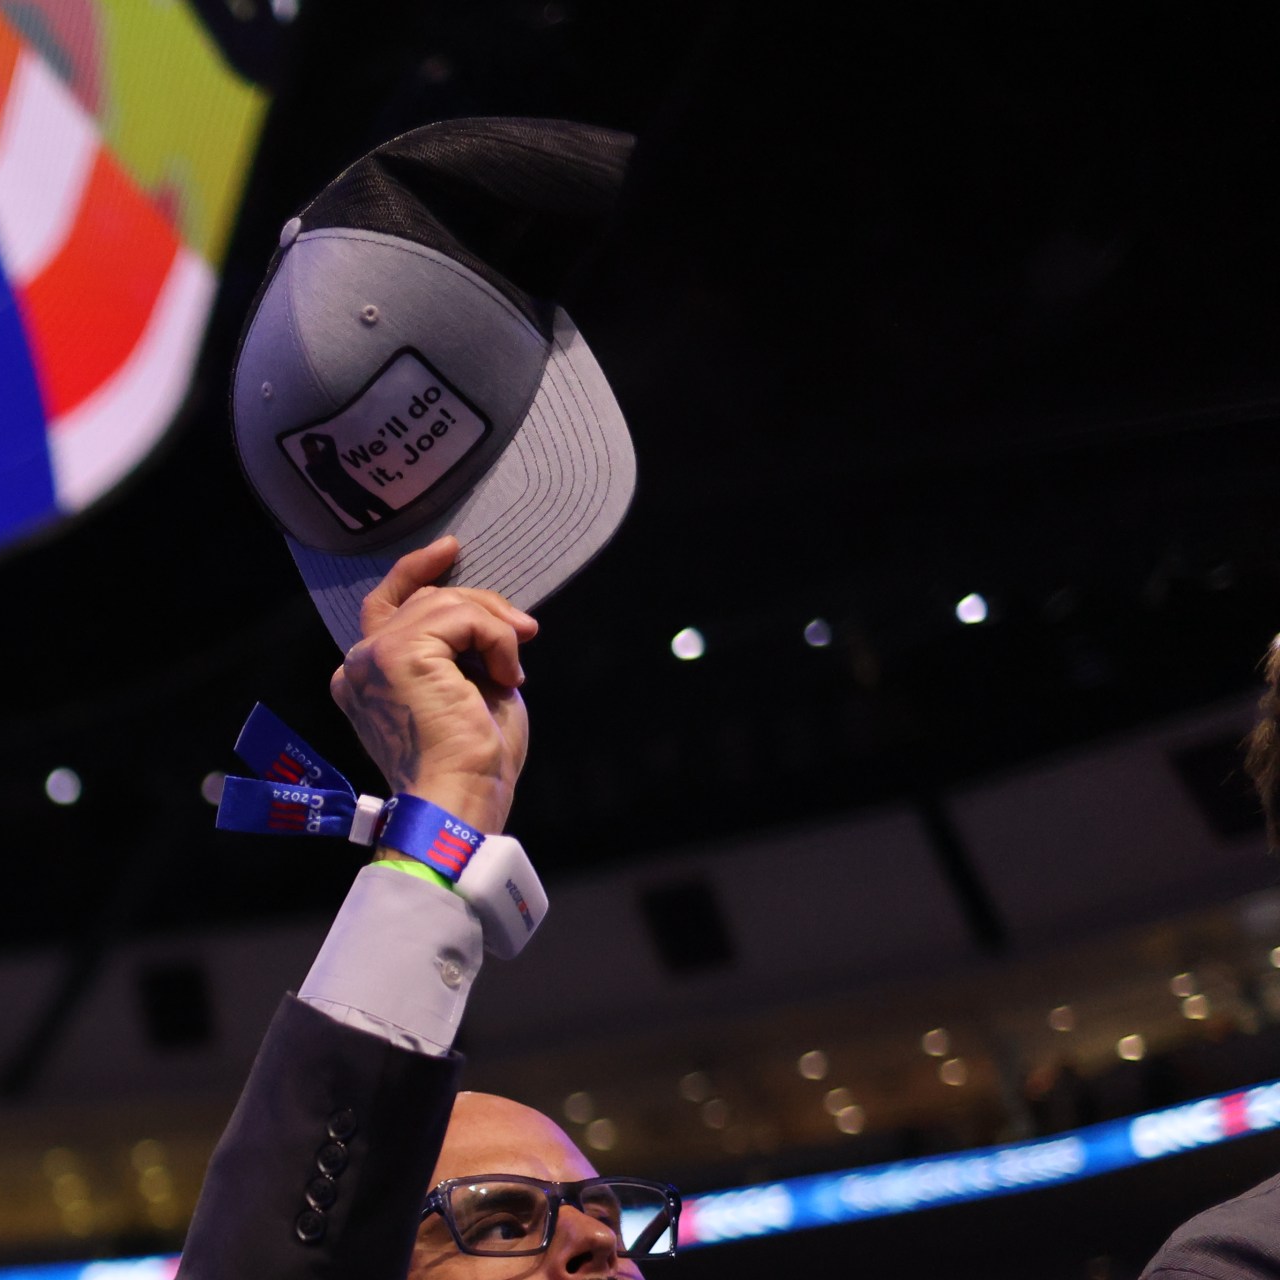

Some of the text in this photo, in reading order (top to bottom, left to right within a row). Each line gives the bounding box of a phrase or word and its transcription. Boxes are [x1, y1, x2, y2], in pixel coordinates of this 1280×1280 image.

[341, 387, 441, 469] We'll do
[368, 408, 456, 487] it, Joe!
[273, 789, 309, 804] 2024
[444, 819, 478, 845] 2024
